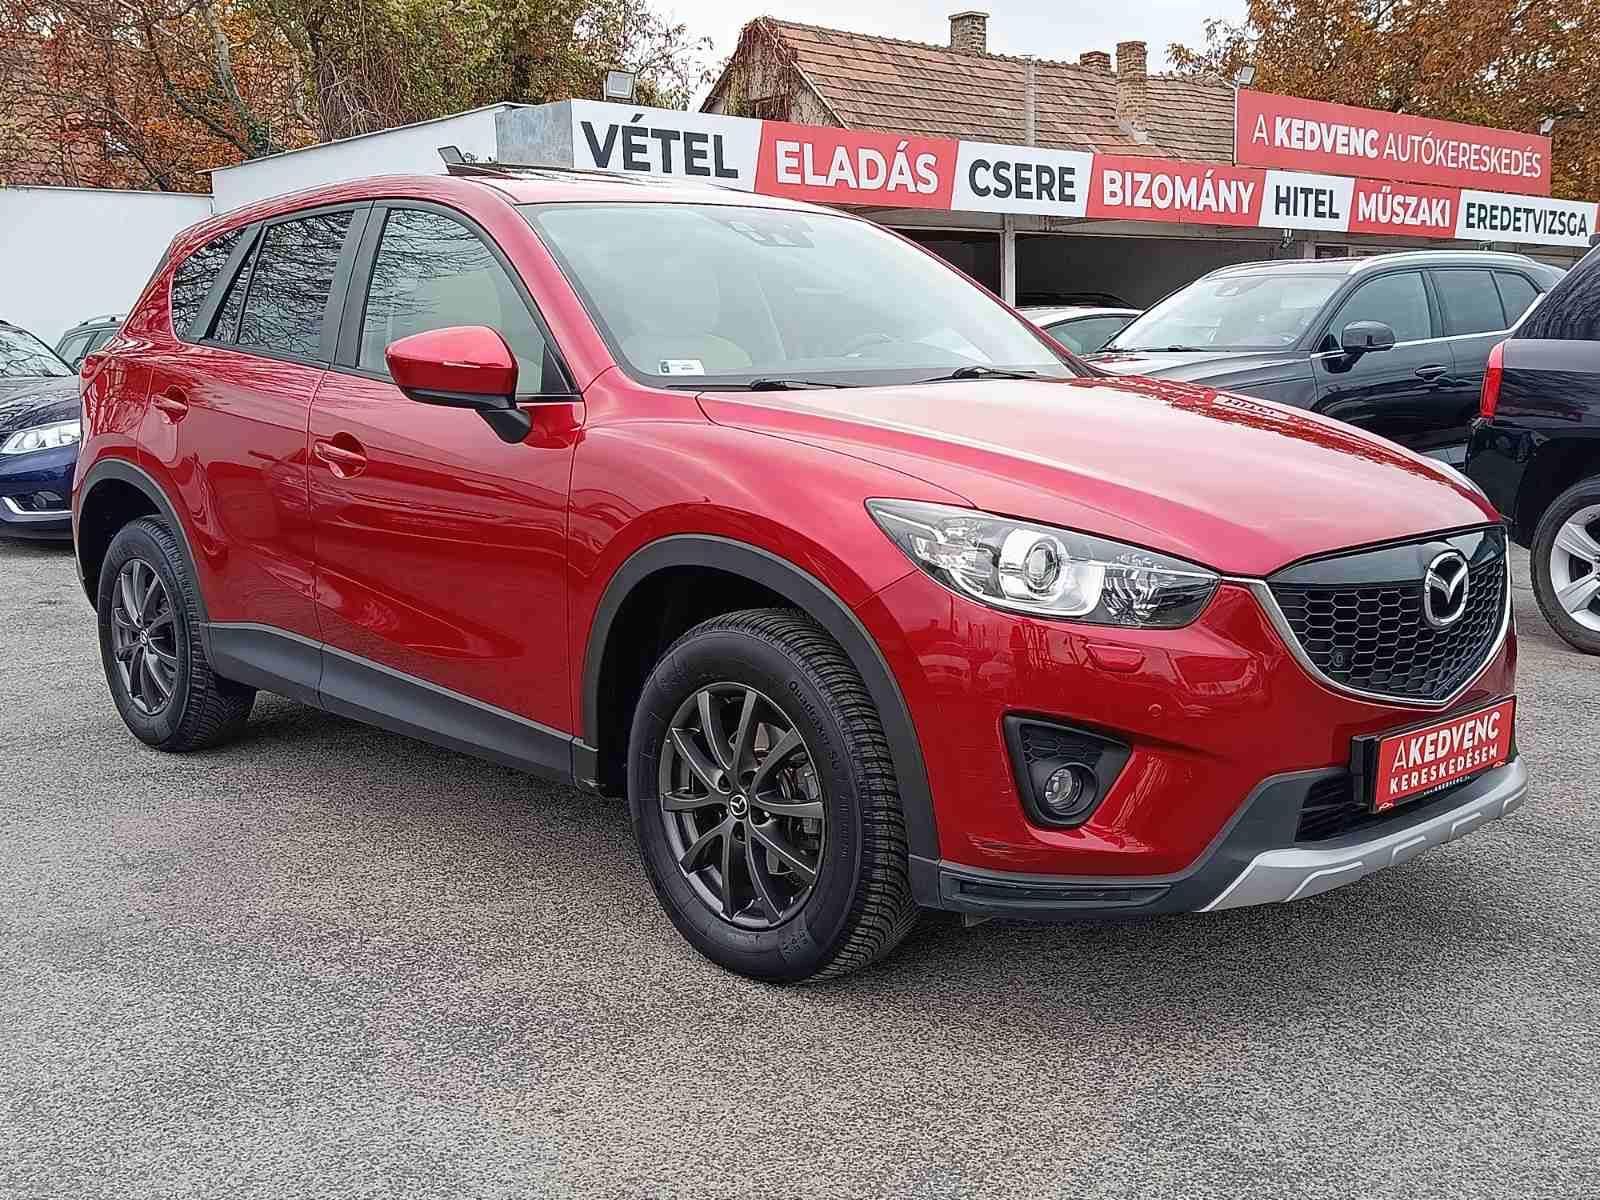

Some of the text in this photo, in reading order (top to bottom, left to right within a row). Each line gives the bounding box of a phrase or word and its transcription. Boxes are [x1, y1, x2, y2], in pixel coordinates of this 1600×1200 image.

[580, 114, 739, 179] VÉTEL
[775, 140, 938, 194] ELADÁS
[1252, 114, 1542, 178] A KEDVENC AUTÓKERESKEDÉS
[968, 158, 1077, 202] CSERE
[1103, 165, 1256, 215] BIZOMÁNY
[1274, 184, 1340, 220] HITEL
[1357, 188, 1450, 228] MŰSZAKI
[1465, 201, 1590, 239] EREDETVIZSGA
[1389, 743, 1499, 795] KERESKEDÉSEM
